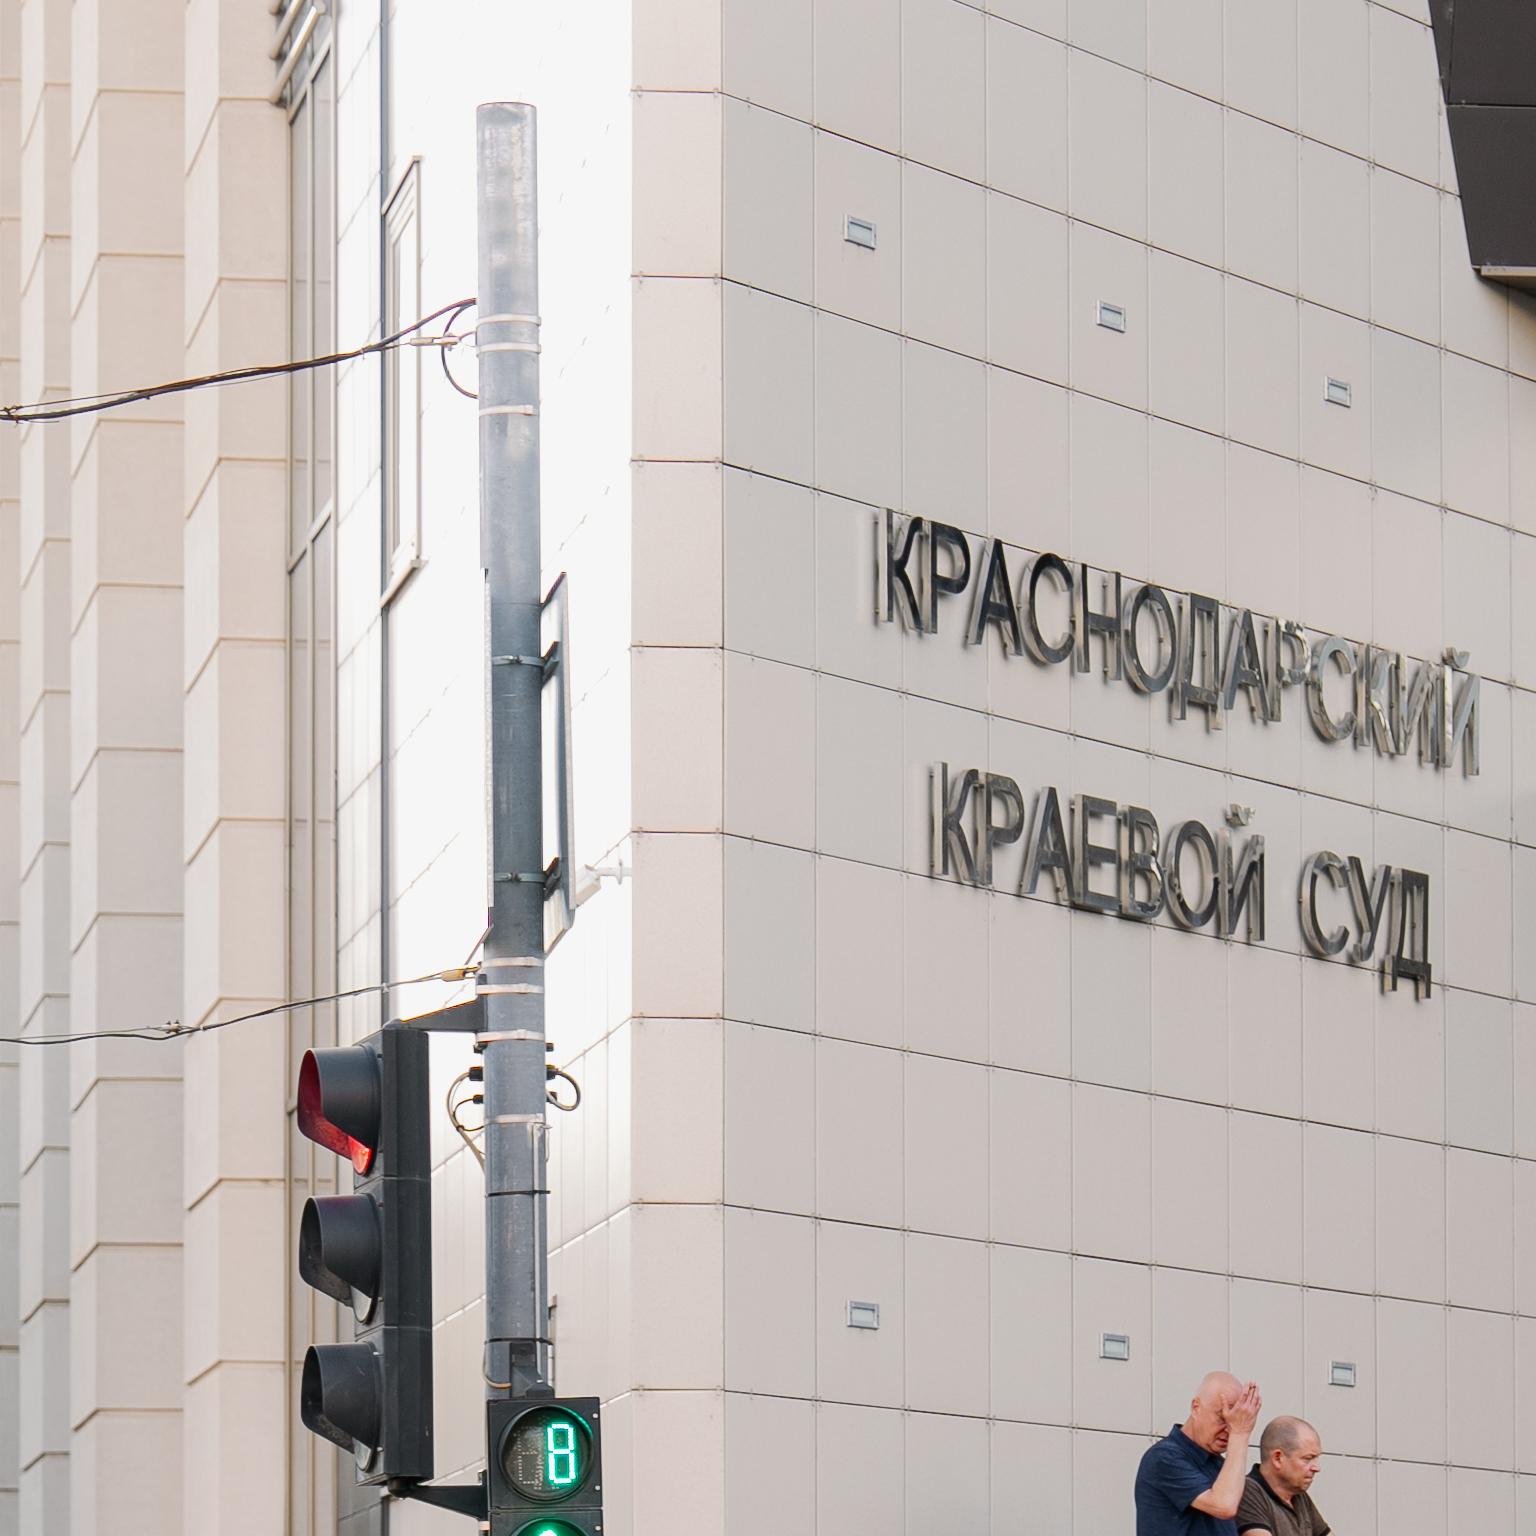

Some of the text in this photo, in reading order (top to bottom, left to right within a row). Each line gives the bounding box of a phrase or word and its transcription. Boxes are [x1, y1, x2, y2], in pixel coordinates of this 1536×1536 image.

[874, 507, 1481, 777] КРАСНОДАРСКИЙ
[927, 760, 1433, 1002] КРАЕВОЙ СУД
[547, 1423, 576, 1484] 8
